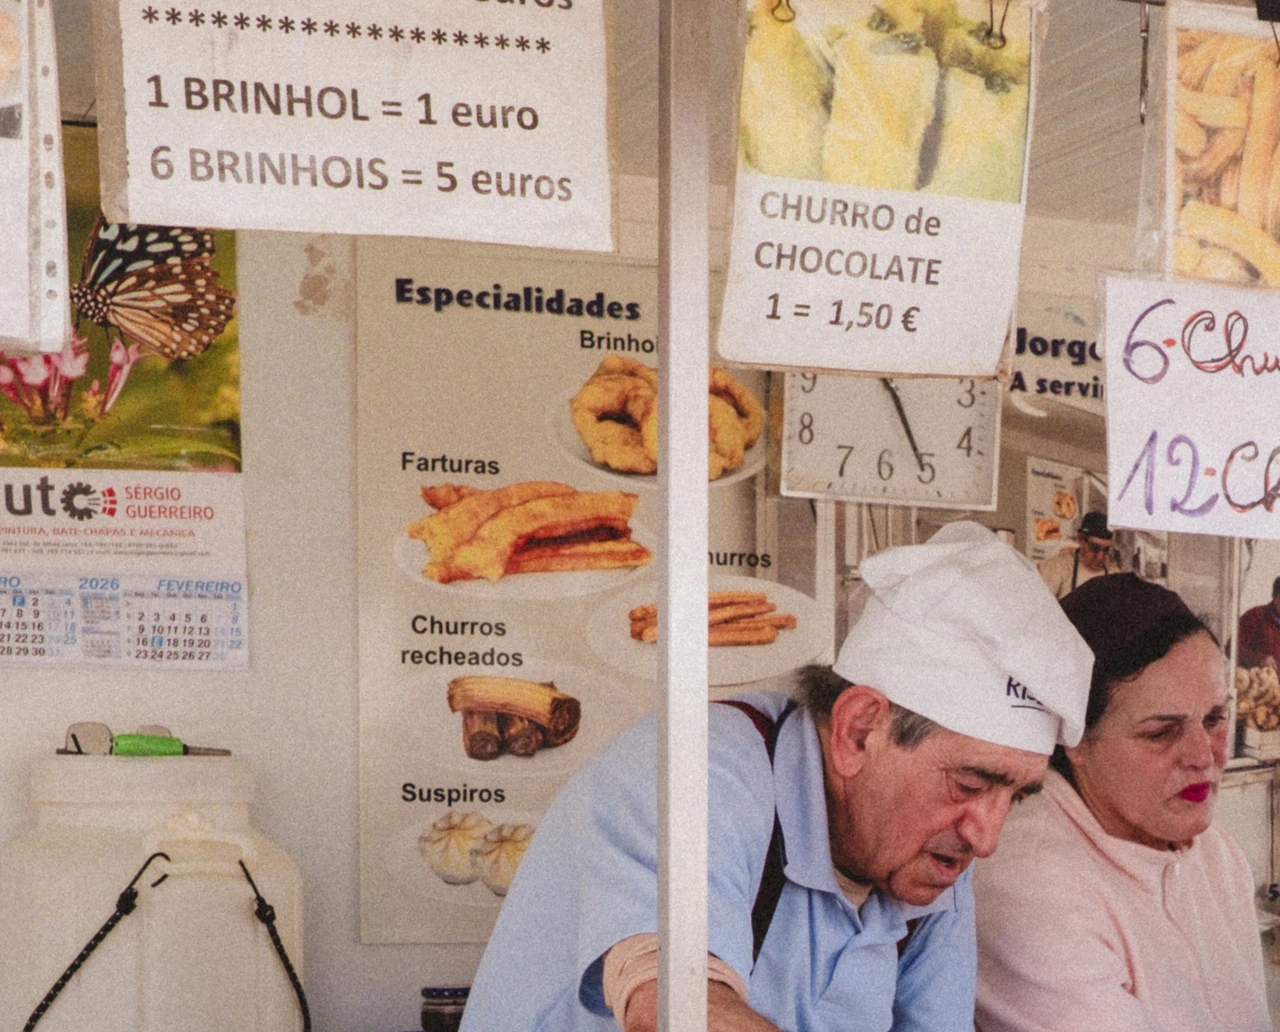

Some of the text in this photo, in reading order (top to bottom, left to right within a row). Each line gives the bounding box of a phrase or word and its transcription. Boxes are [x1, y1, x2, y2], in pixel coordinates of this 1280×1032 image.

[147, 75, 169, 108] 1
[184, 77, 370, 122] BRINHOL
[417, 92, 438, 125] 1
[451, 101, 540, 131] euro
[150, 145, 174, 181] 6
[189, 147, 389, 191] BRINHOIS
[436, 161, 458, 193] 5
[470, 169, 573, 202] euros
[760, 191, 941, 236] CHURRO de
[754, 241, 942, 285] CHOCOLATE
[395, 278, 641, 321] Especialidades
[765, 293, 781, 320] 1
[1009, 371, 1027, 392] A
[799, 412, 973, 458] 8 4
[401, 452, 500, 475] Farturas
[837, 445, 935, 484] 7 6 5
[125, 484, 182, 500] SÉRGIO
[126, 505, 214, 520] GUERREIRO
[708, 551, 772, 568] urros
[79, 577, 120, 590] 2026
[158, 579, 242, 593] FEVEREIRO
[411, 615, 506, 636] Churros
[401, 648, 523, 667] recheados
[401, 783, 506, 806] Suspiros
